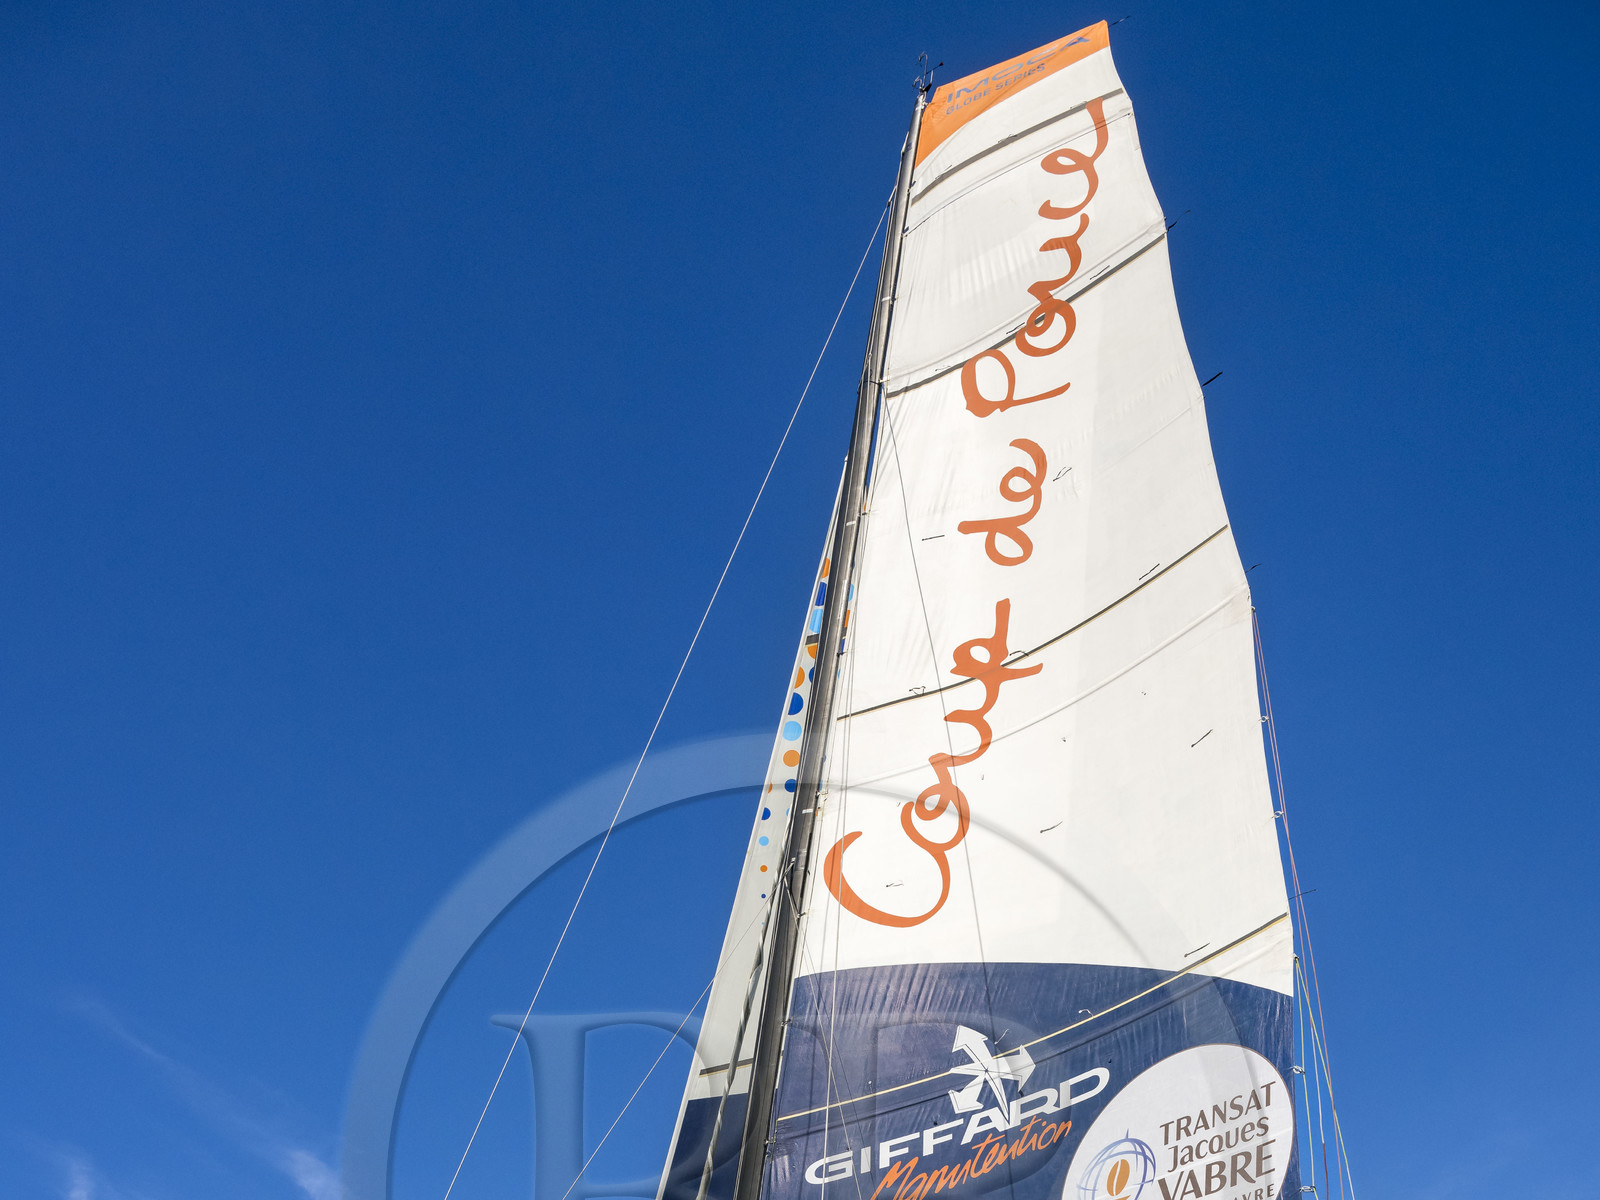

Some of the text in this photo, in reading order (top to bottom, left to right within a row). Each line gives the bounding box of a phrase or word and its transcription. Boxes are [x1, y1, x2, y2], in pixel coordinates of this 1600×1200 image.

[945, 63, 1046, 115] GLOBE SERIES
[946, 36, 1091, 103] IMOCA
[957, 438, 1048, 566] de
[804, 1067, 1110, 1186] GIFFARD
[1160, 1081, 1277, 1147] TRANSAT
[1166, 1116, 1270, 1173] Jacques
